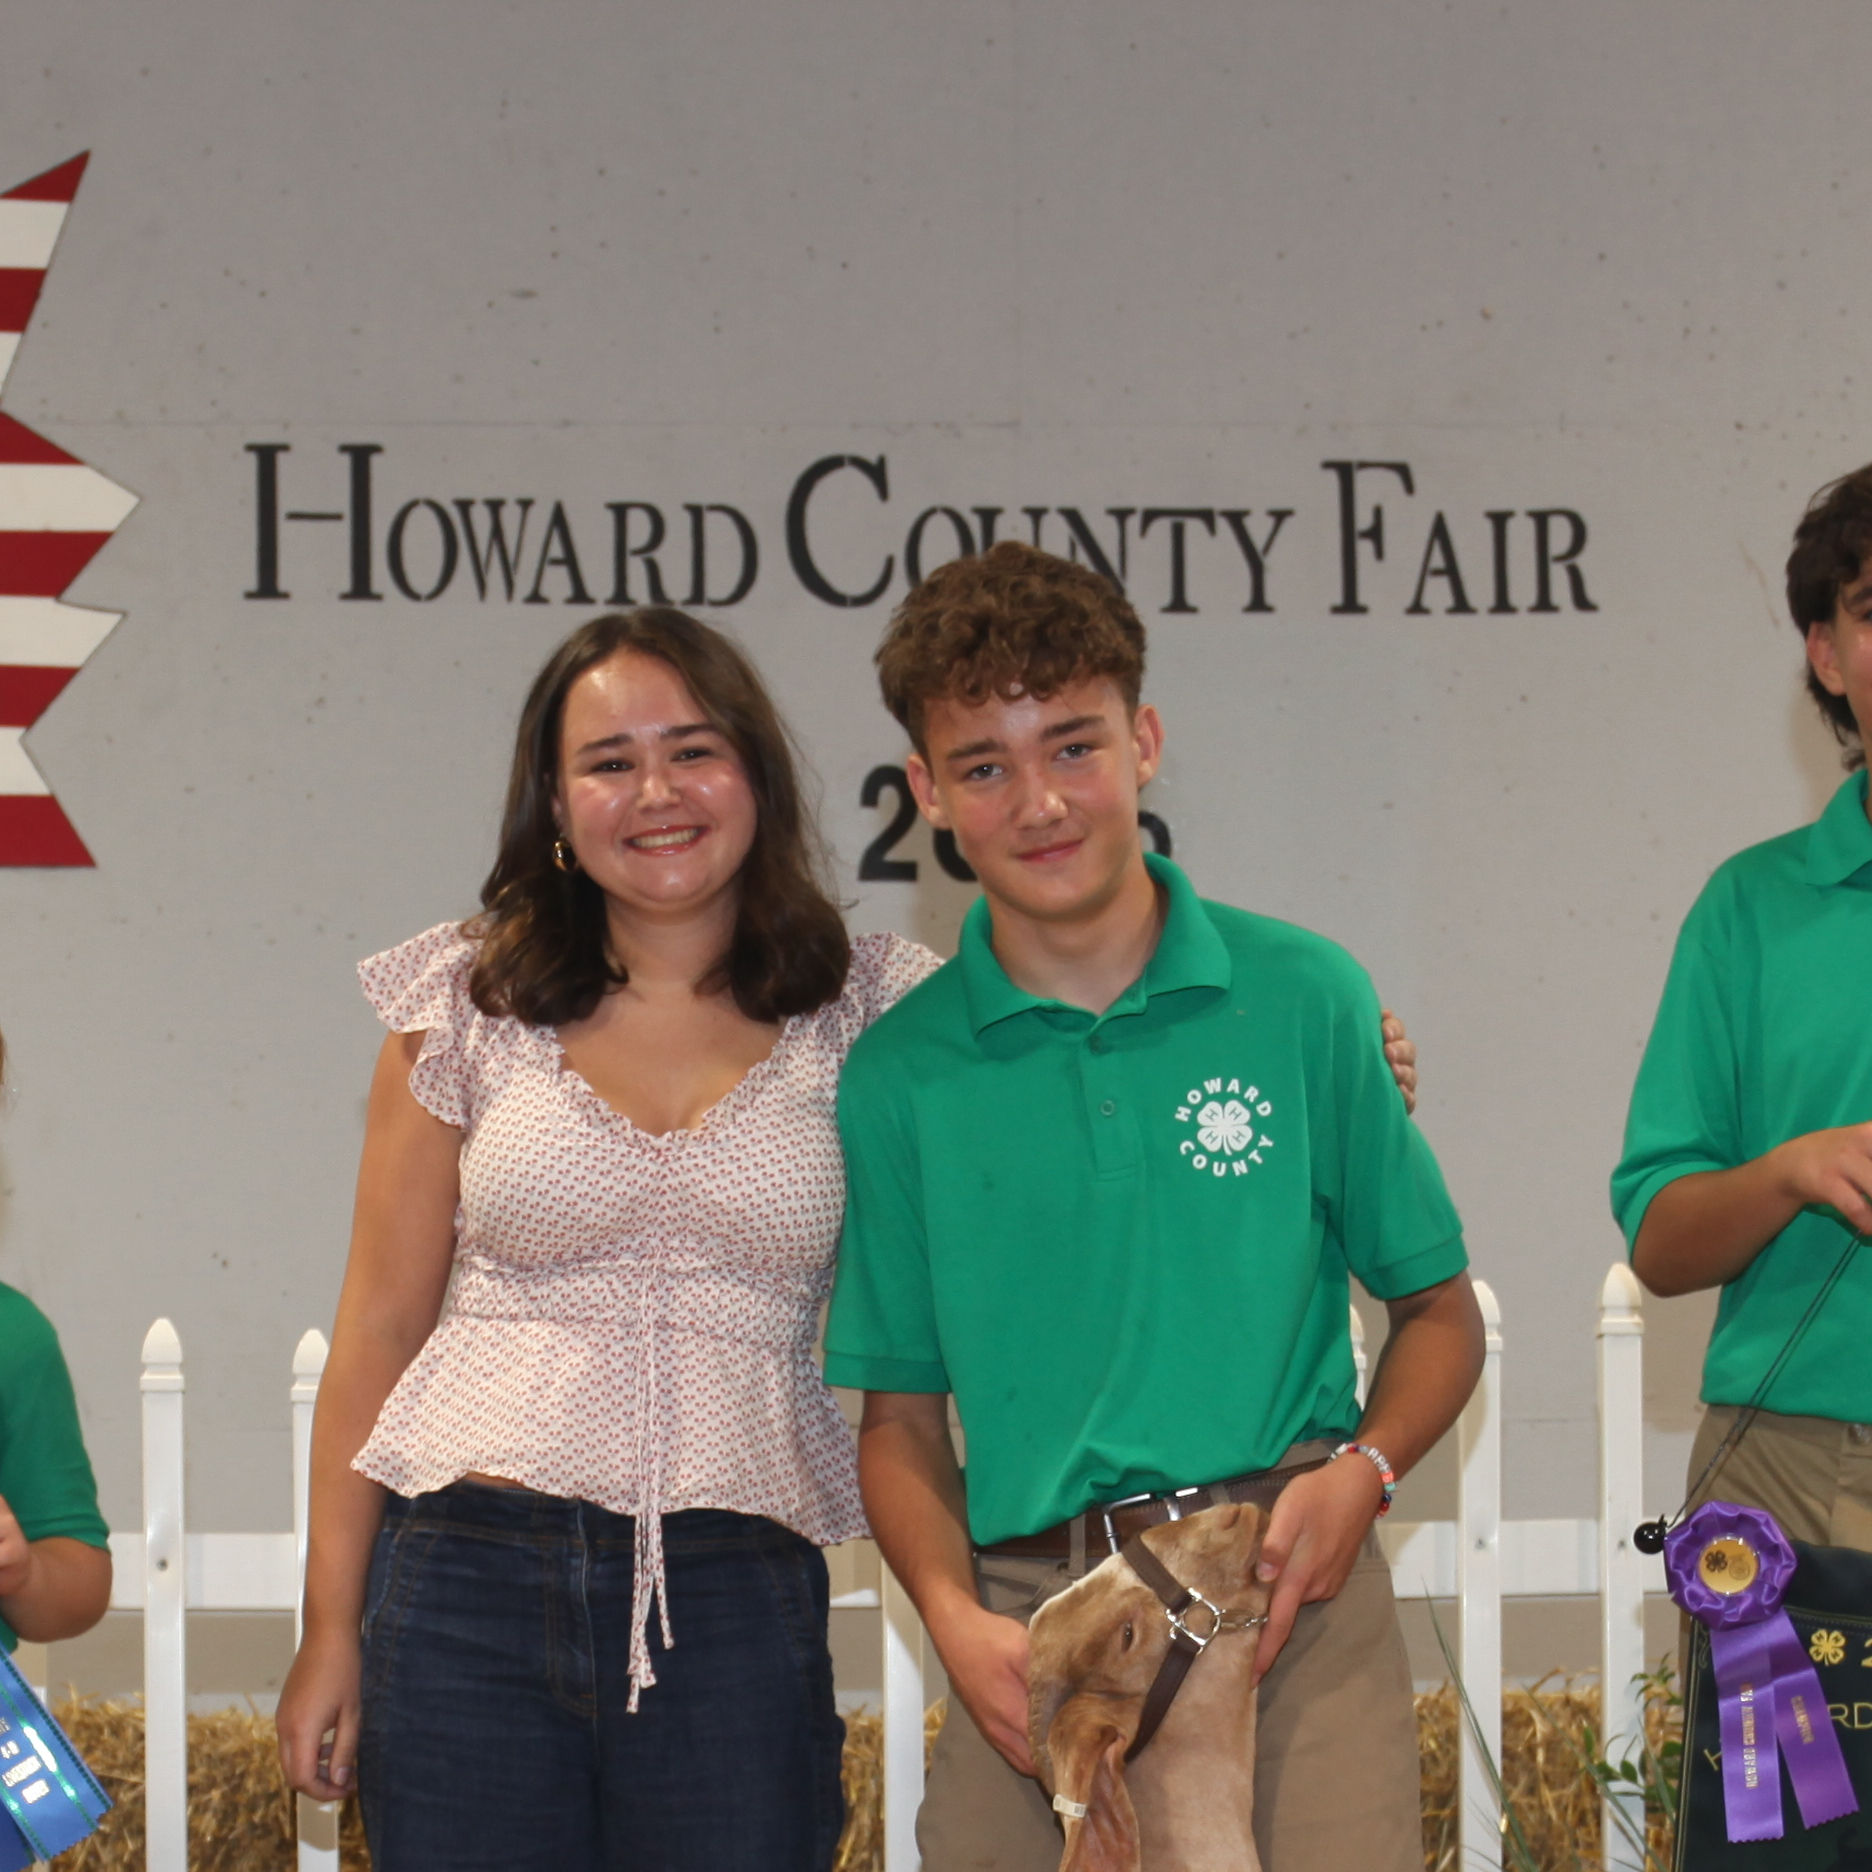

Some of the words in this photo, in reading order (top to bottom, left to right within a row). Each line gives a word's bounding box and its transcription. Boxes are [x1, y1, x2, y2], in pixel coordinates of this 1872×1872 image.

[244, 443, 759, 607] HOWARD
[1321, 460, 1599, 615] FAIR
[1174, 1077, 1273, 1122] HOWARD
[1179, 1134, 1274, 1177] COUNTY
